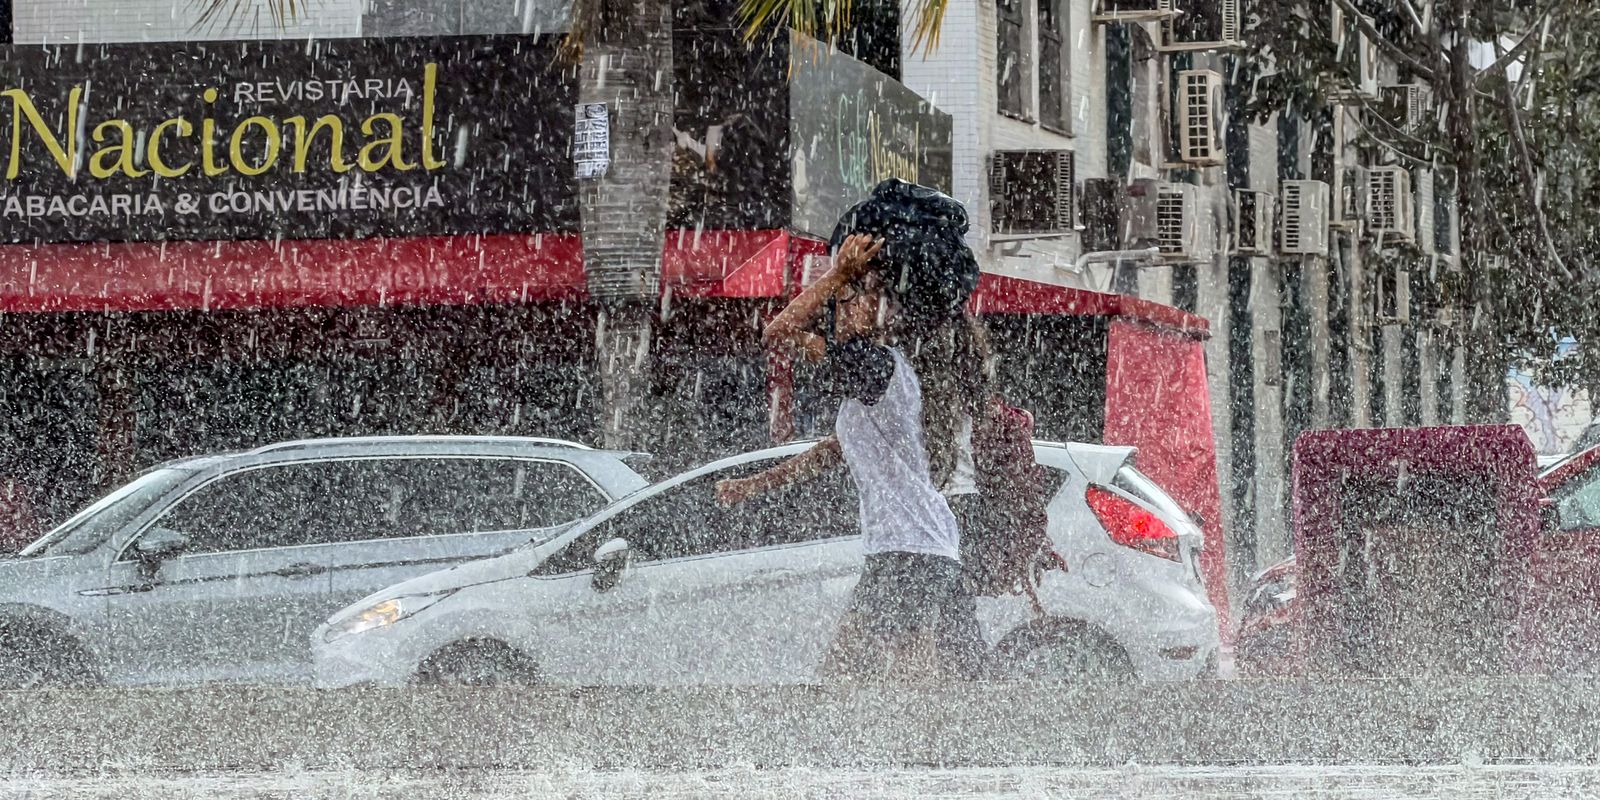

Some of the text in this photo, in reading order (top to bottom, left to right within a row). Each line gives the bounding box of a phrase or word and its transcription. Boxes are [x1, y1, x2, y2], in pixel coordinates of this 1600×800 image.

[0, 62, 447, 180] Nacional
[0, 193, 164, 218] ABACARIA
[174, 192, 200, 214] &
